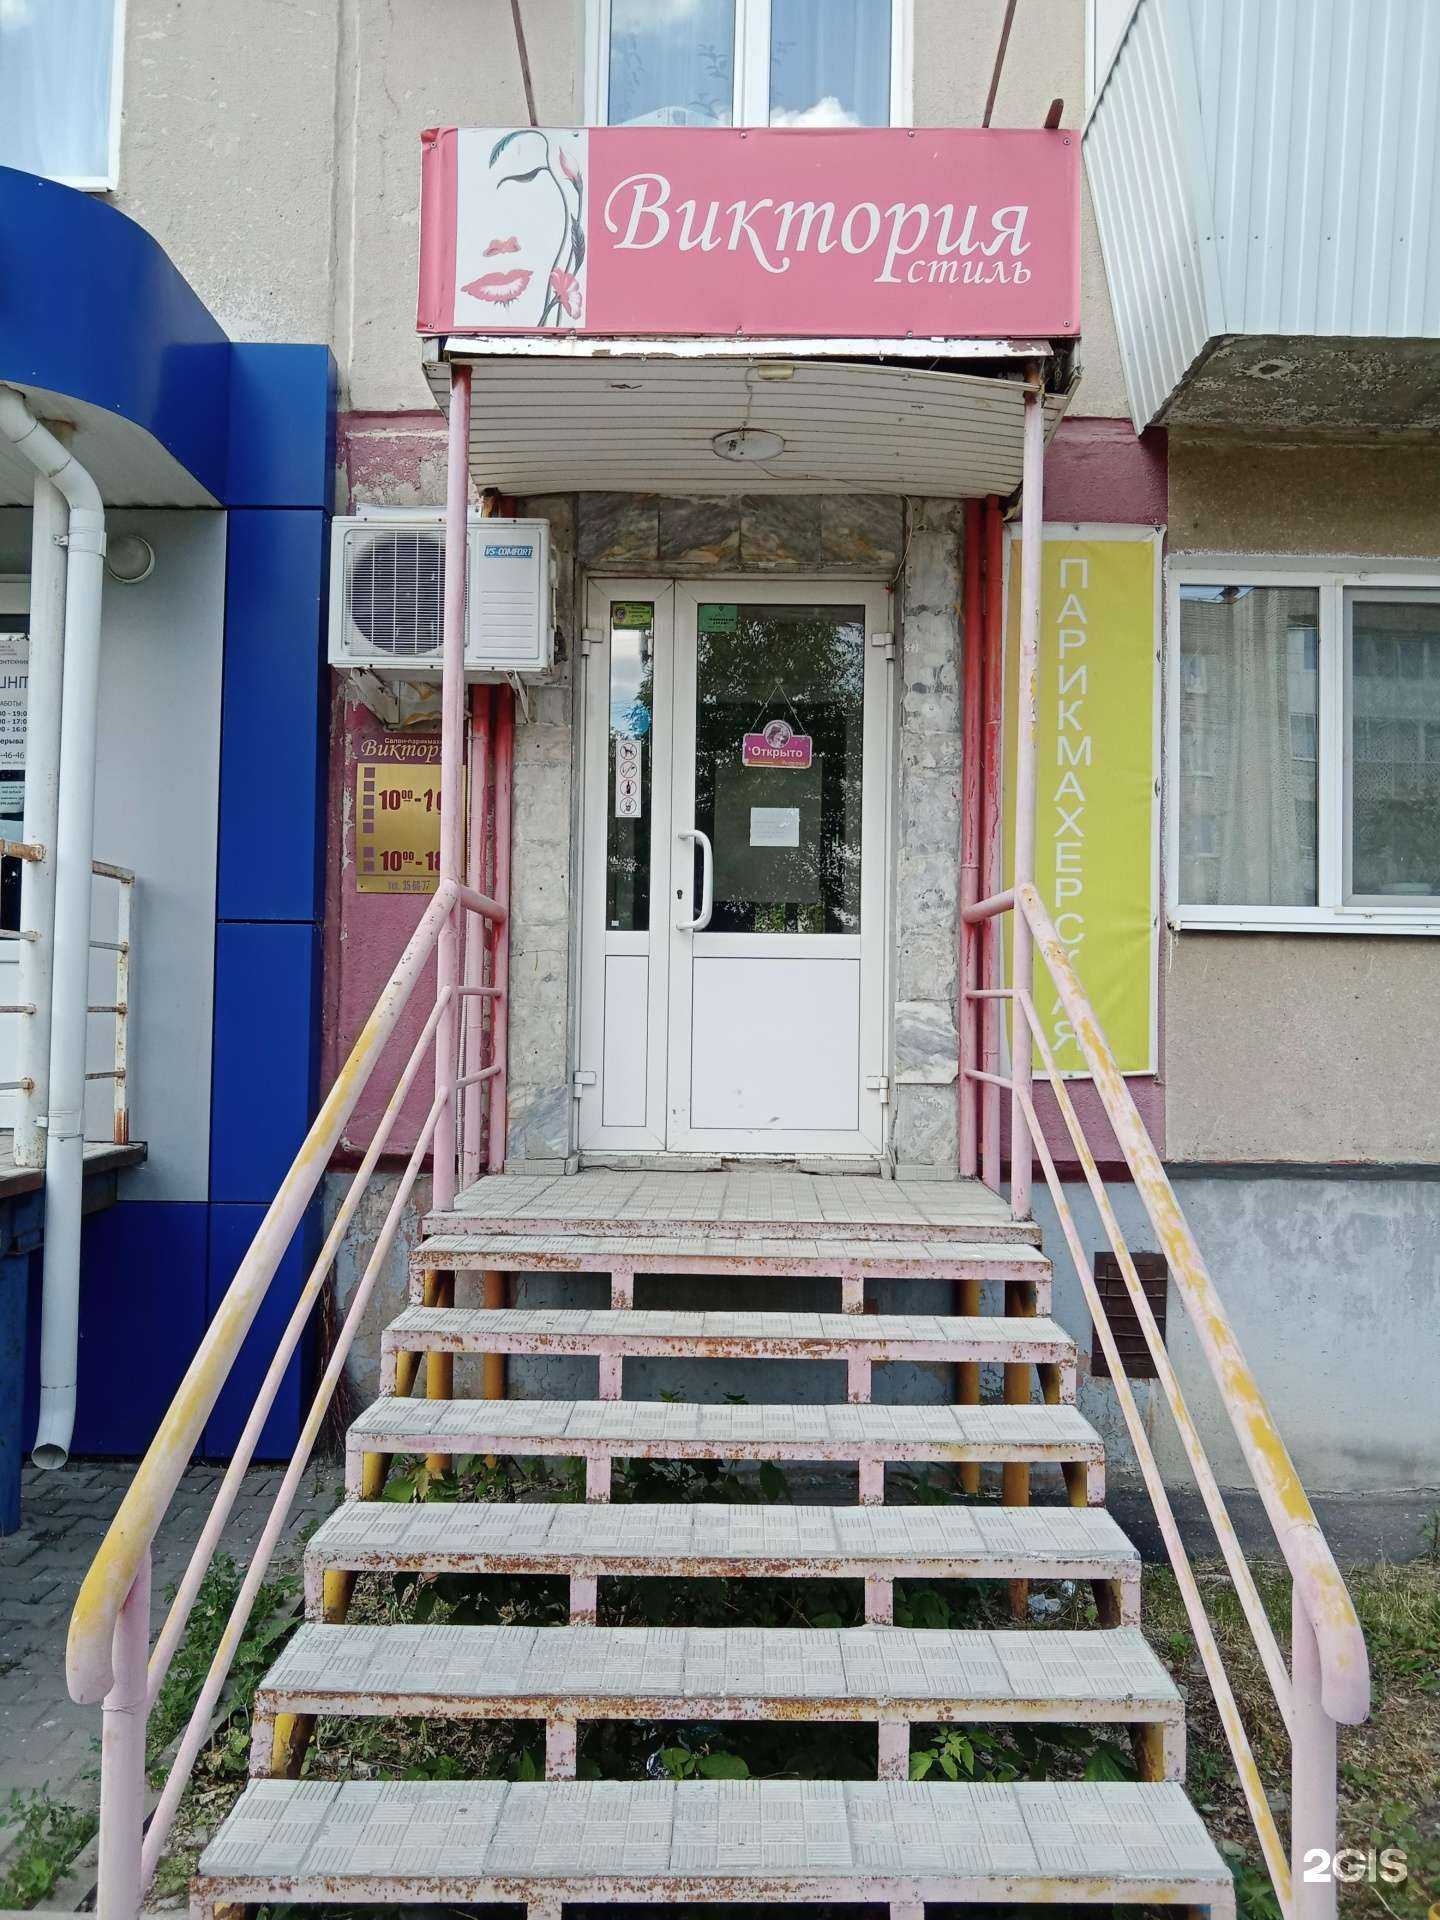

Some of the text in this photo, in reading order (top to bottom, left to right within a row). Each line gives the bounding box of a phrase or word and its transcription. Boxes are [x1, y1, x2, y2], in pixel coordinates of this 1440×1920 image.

[604, 173, 1031, 283] Виктория
[907, 260, 1032, 284] стиль
[361, 739, 441, 763] Виктор
[751, 746, 803, 758] Открыто
[1052, 558, 1092, 1052] ПАРИКМАХЕРСЯ
